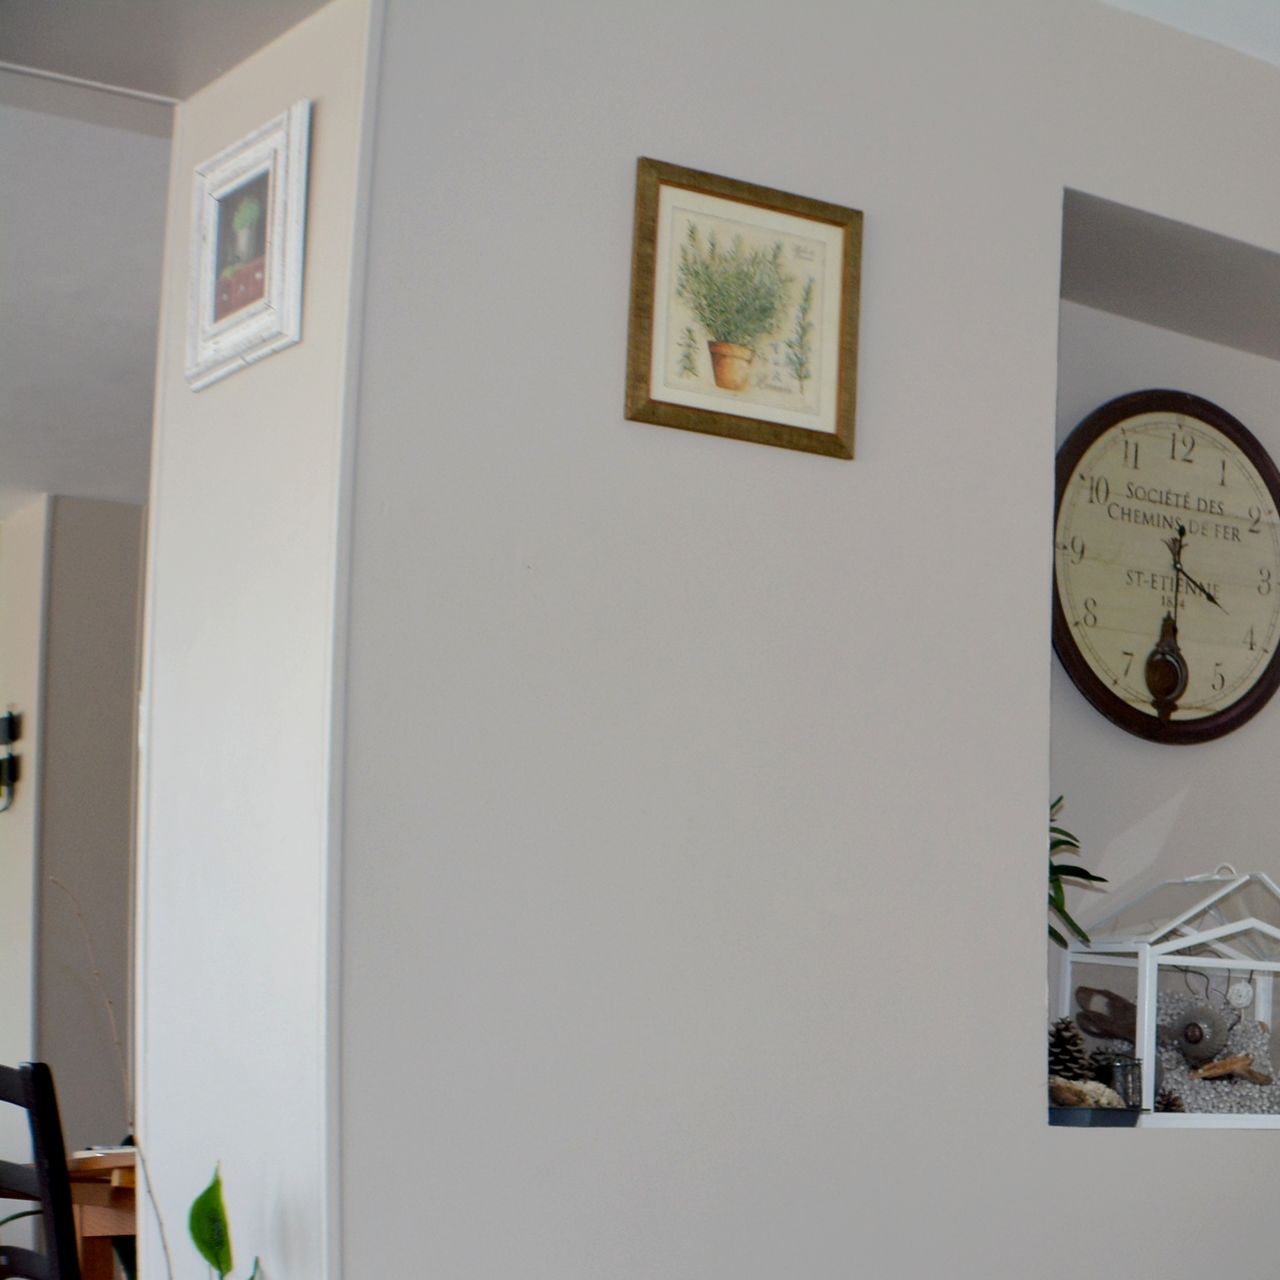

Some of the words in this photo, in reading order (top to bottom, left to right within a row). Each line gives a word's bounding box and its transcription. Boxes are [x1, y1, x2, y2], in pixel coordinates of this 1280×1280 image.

[1122, 439, 1139, 471] 11
[1169, 432, 1195, 464] 12
[1218, 459, 1226, 487] 1
[1087, 476, 1108, 505] 10
[1196, 496, 1224, 517] DES
[1248, 506, 1263, 534] 2
[1106, 502, 1183, 533] CHEMINS
[1214, 523, 1241, 544] FER
[1070, 535, 1086, 566] 9
[1256, 567, 1270, 597] 3
[1082, 598, 1098, 628] 8
[1241, 624, 1255, 652] 4
[1119, 650, 1133, 679] 7
[1209, 662, 1224, 692] 5
